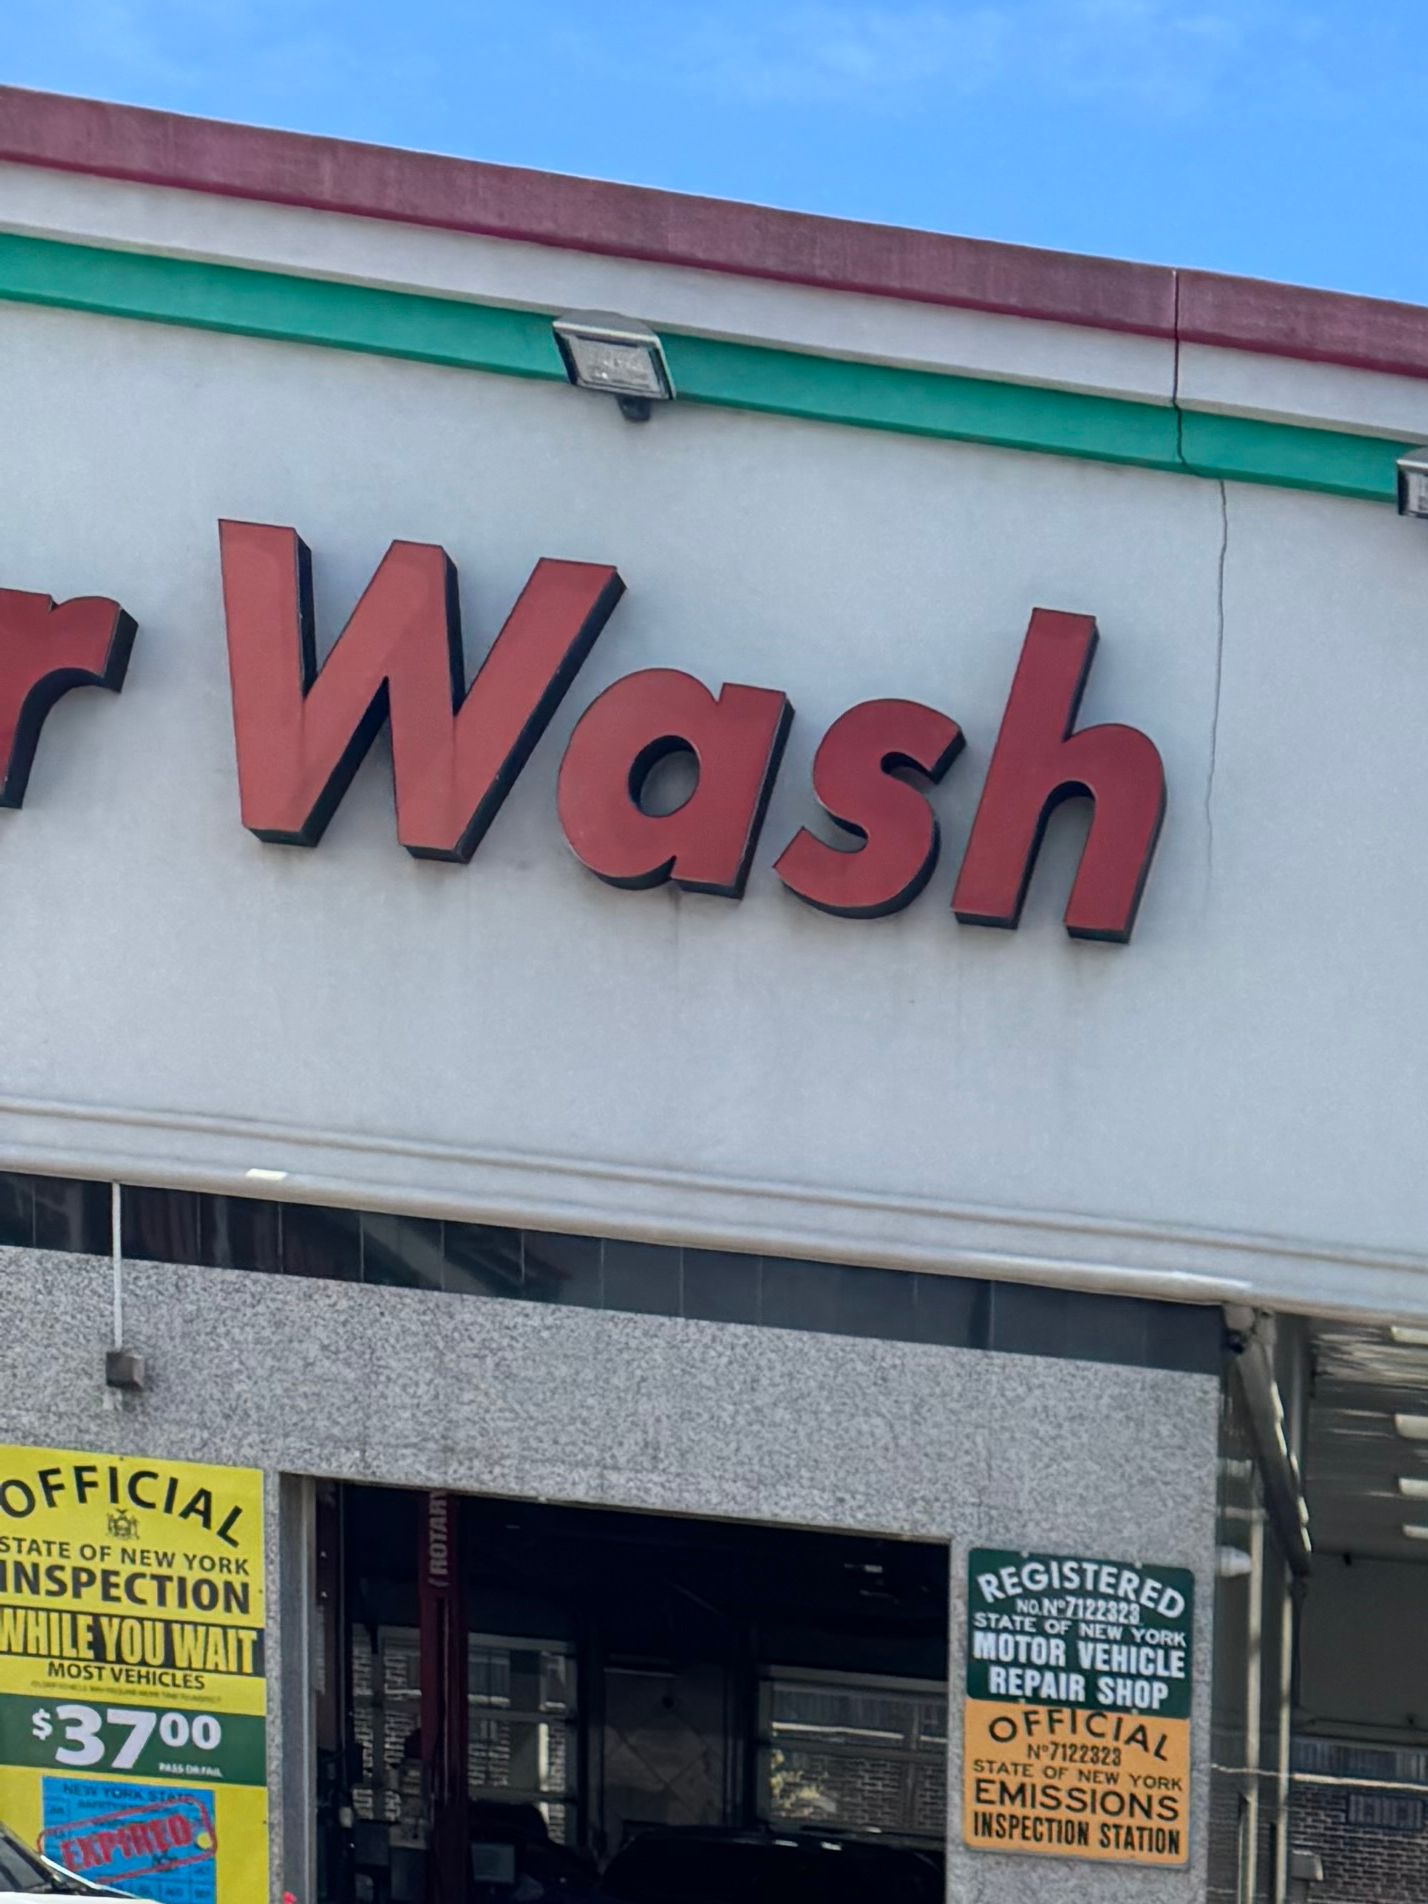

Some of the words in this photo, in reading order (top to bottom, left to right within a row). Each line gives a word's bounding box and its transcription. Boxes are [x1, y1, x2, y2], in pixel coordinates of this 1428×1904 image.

[219, 519, 1166, 943] Wash
[0, 1466, 243, 1549] OFFICIAL
[0, 1536, 71, 1559] STATE
[79, 1544, 112, 1563] OF
[121, 1548, 176, 1569] NEW
[182, 1552, 250, 1576] YORK
[0, 1560, 250, 1615] INSPECTION
[977, 1560, 1186, 1618] REGISTERED
[0, 1607, 94, 1661] WHILE
[99, 1616, 165, 1667] YOU
[170, 1622, 257, 1673] WAIT
[974, 1612, 1036, 1633] STATE
[1044, 1619, 1072, 1635] OF
[1079, 1622, 1123, 1640] NEW
[1130, 1627, 1187, 1648] YORK
[48, 1661, 108, 1681] MOST
[109, 1667, 206, 1690] VEHICLES
[973, 1631, 1066, 1667] MOTOR
[1077, 1641, 1186, 1678] VEHICLE
[989, 1666, 1085, 1702] REPAIR
[1096, 1676, 1169, 1710] SHOP
[989, 1709, 1168, 1761] OFFICIAL
[973, 1760, 1034, 1778] STATE
[1043, 1766, 1068, 1780] OF
[1078, 1769, 1120, 1785] NEW
[1129, 1774, 1183, 1792] YORK
[975, 1778, 1179, 1822] EMISSIONS
[60, 1814, 192, 1872] EXPIRED
[974, 1811, 1089, 1847] INSPECTION
[1100, 1823, 1180, 1855] STATION
